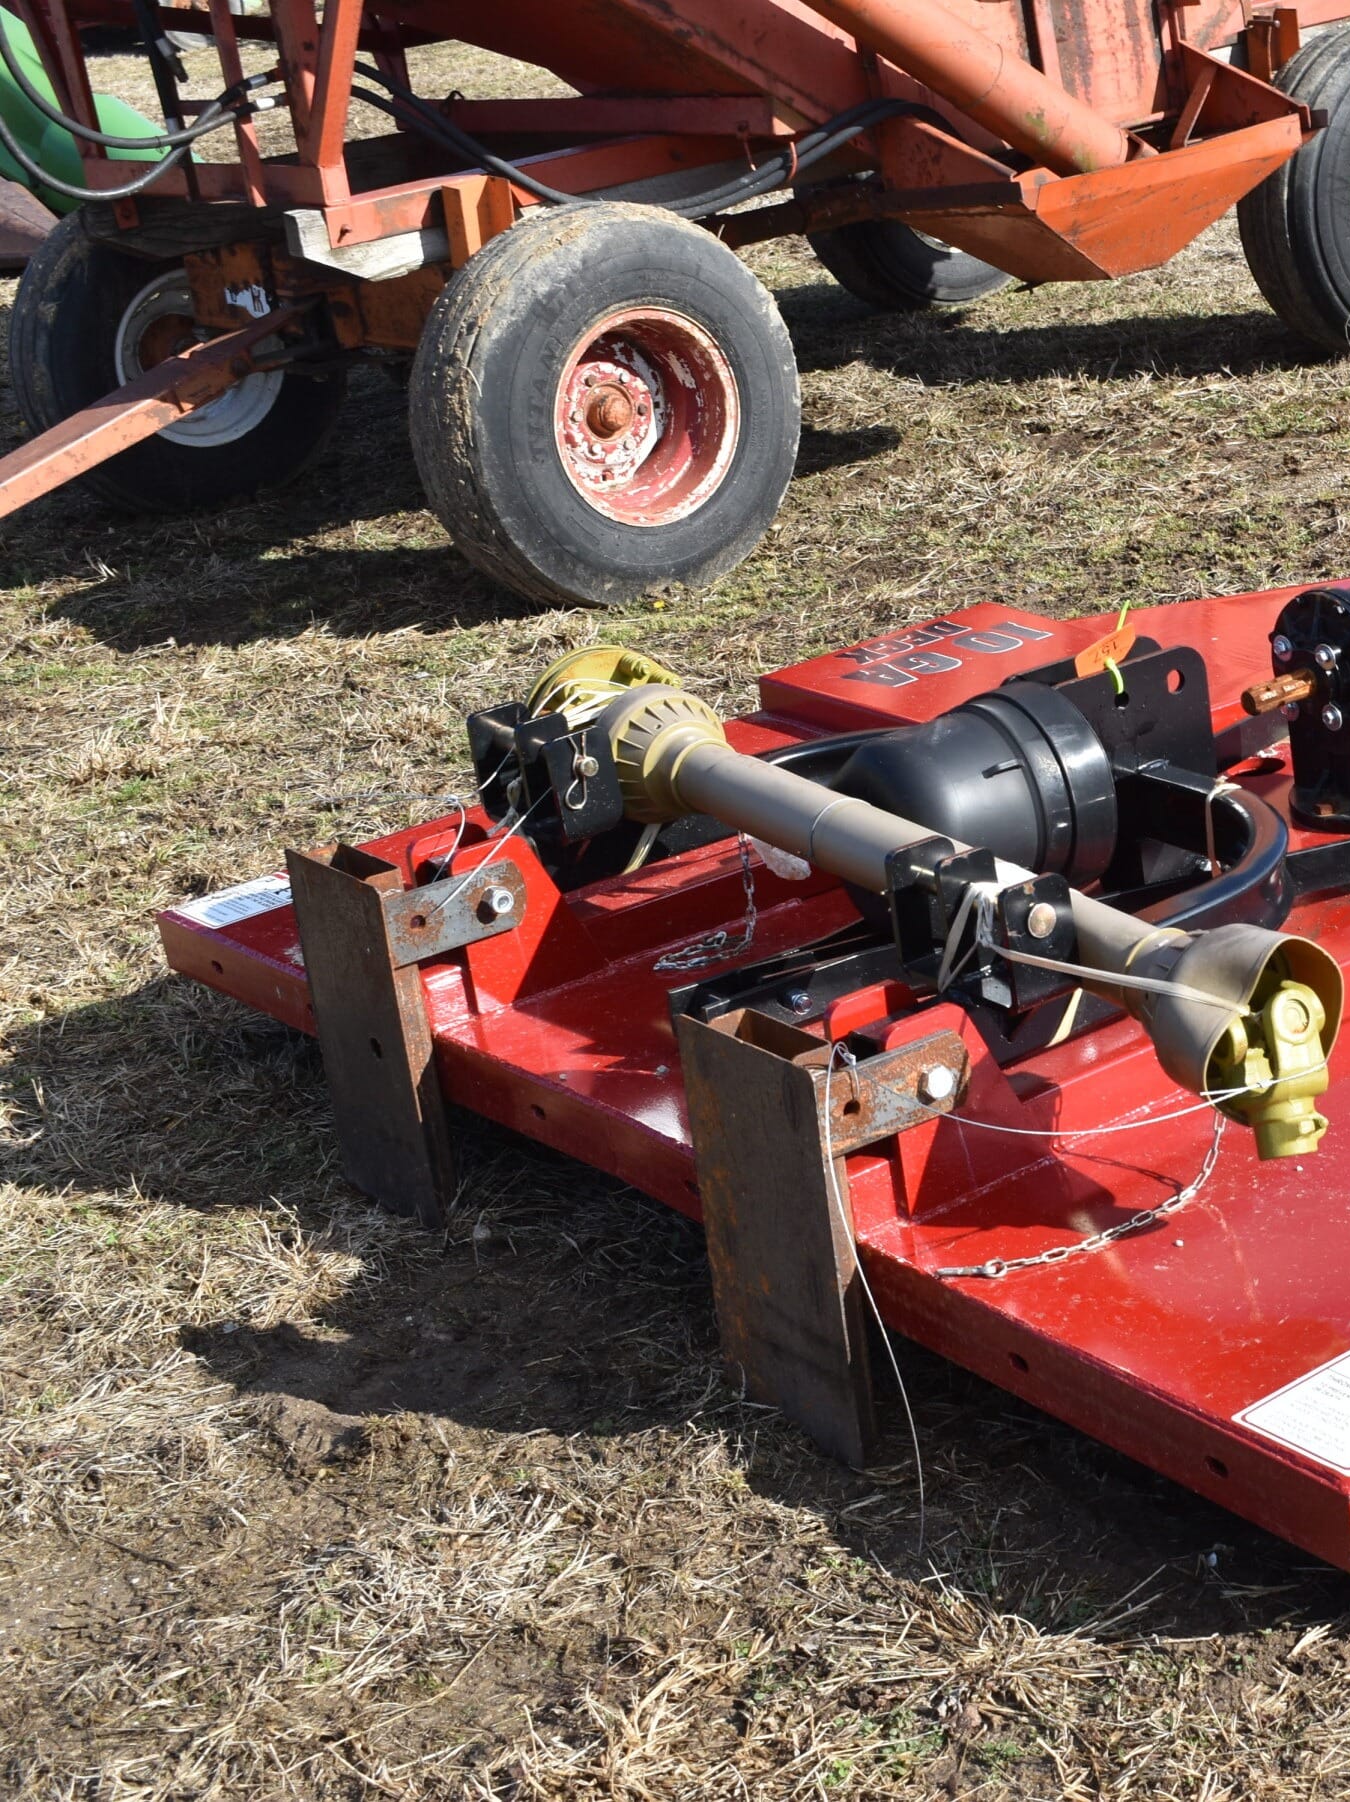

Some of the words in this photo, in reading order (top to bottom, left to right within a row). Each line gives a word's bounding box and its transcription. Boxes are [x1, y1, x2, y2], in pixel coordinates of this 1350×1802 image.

[834, 620, 973, 666] DECK
[952, 621, 1054, 654] 10
[839, 652, 963, 688] GA
